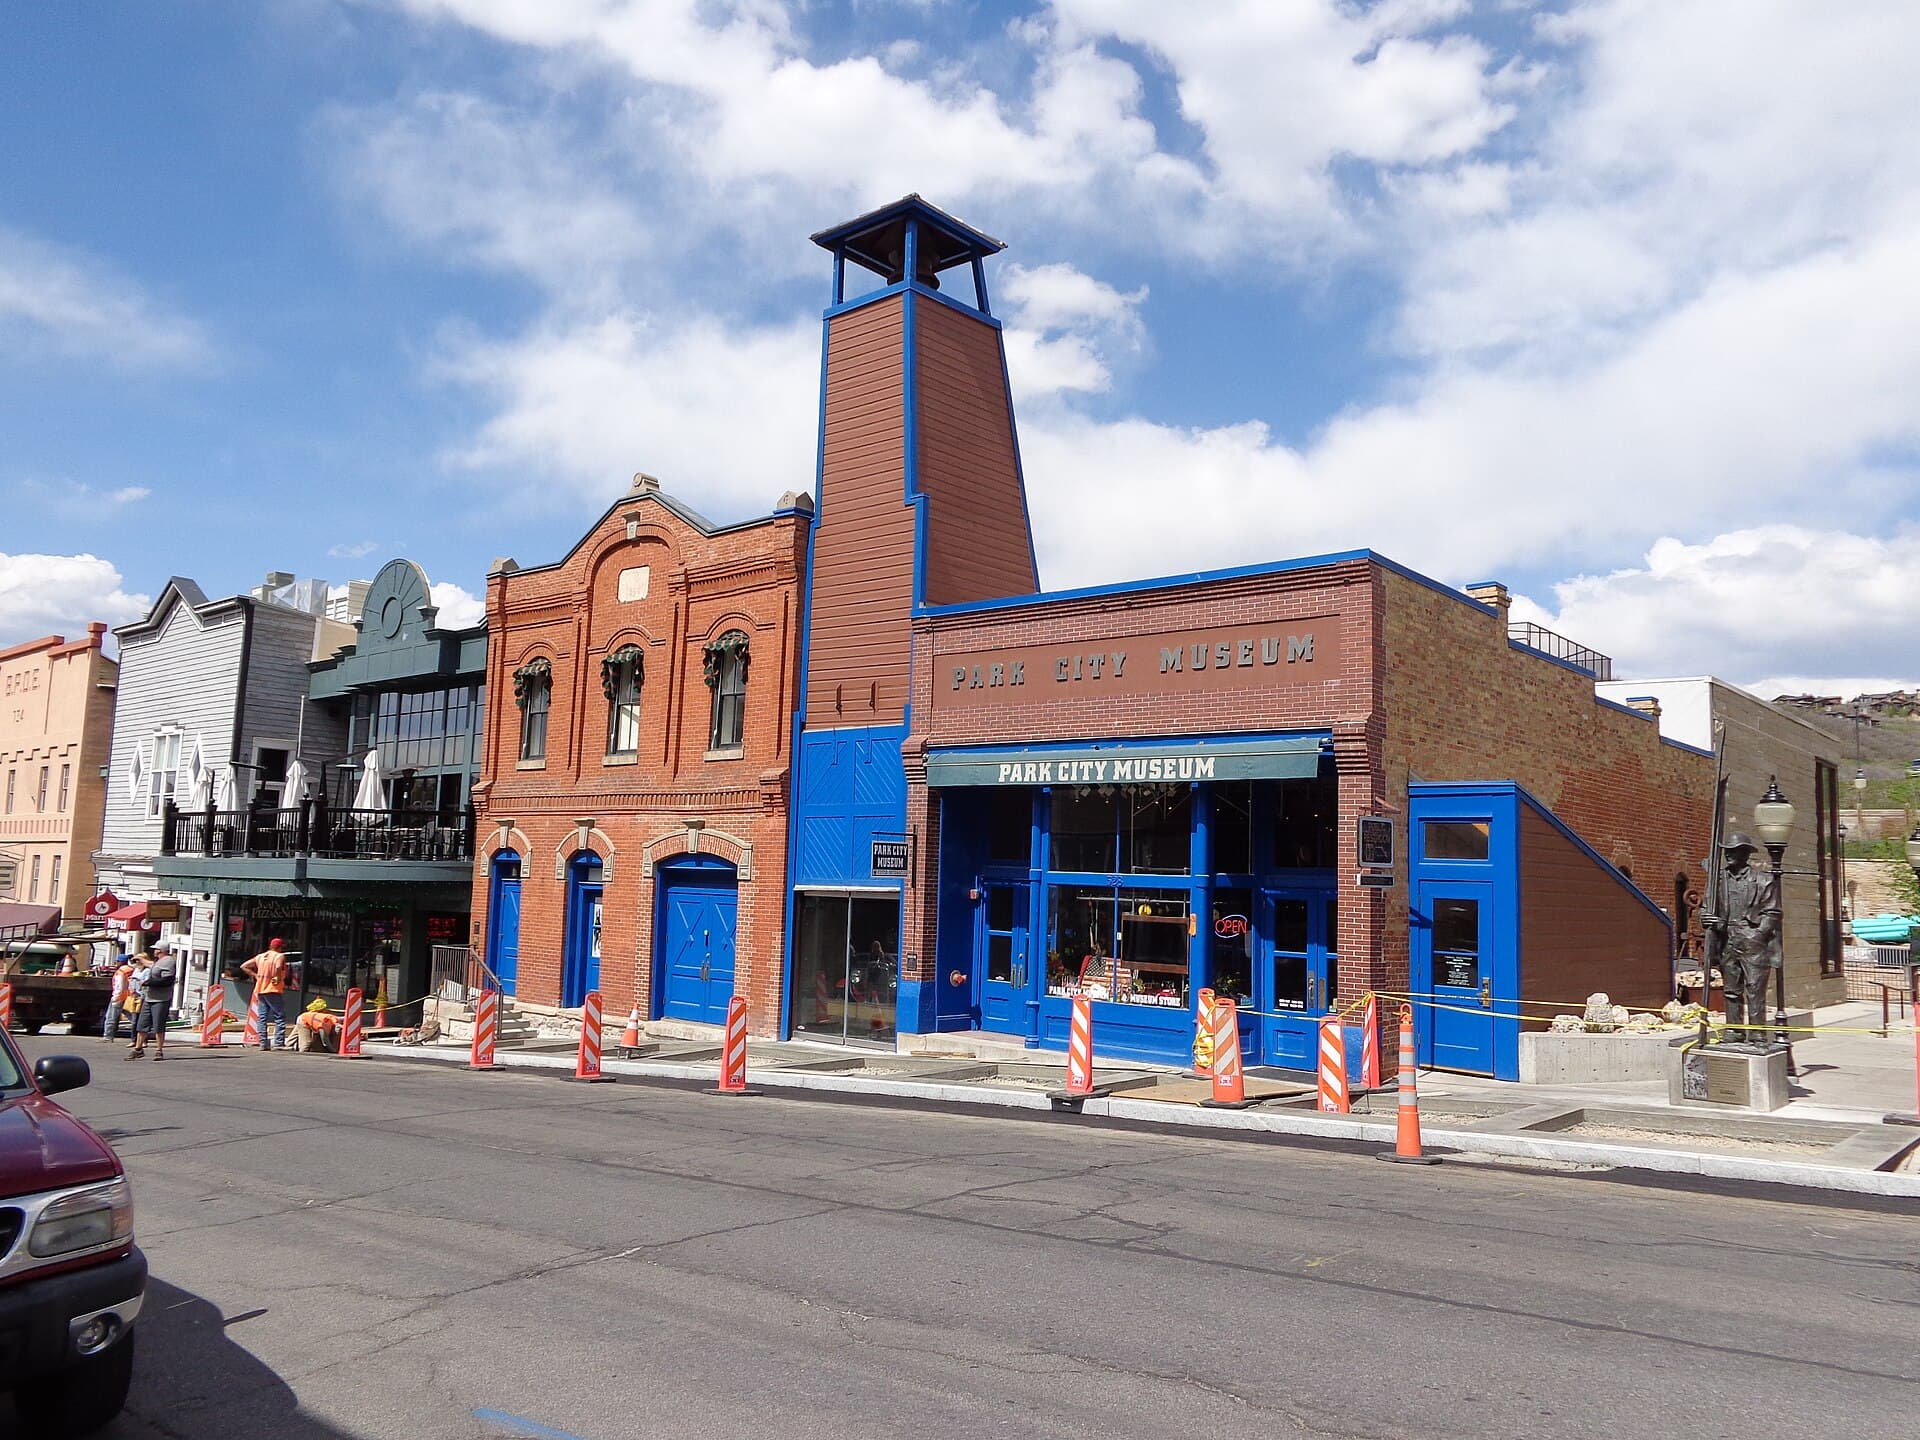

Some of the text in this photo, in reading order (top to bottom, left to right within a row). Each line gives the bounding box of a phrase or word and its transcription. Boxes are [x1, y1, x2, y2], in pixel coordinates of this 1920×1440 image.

[952, 633, 1315, 690] PARK CITY MUSEUM
[998, 757, 1216, 782] PARK CITY MUSEUM
[874, 845, 908, 856] PARK CITY
[877, 857, 904, 868] MUSEUM
[1215, 919, 1248, 934] OPEN
